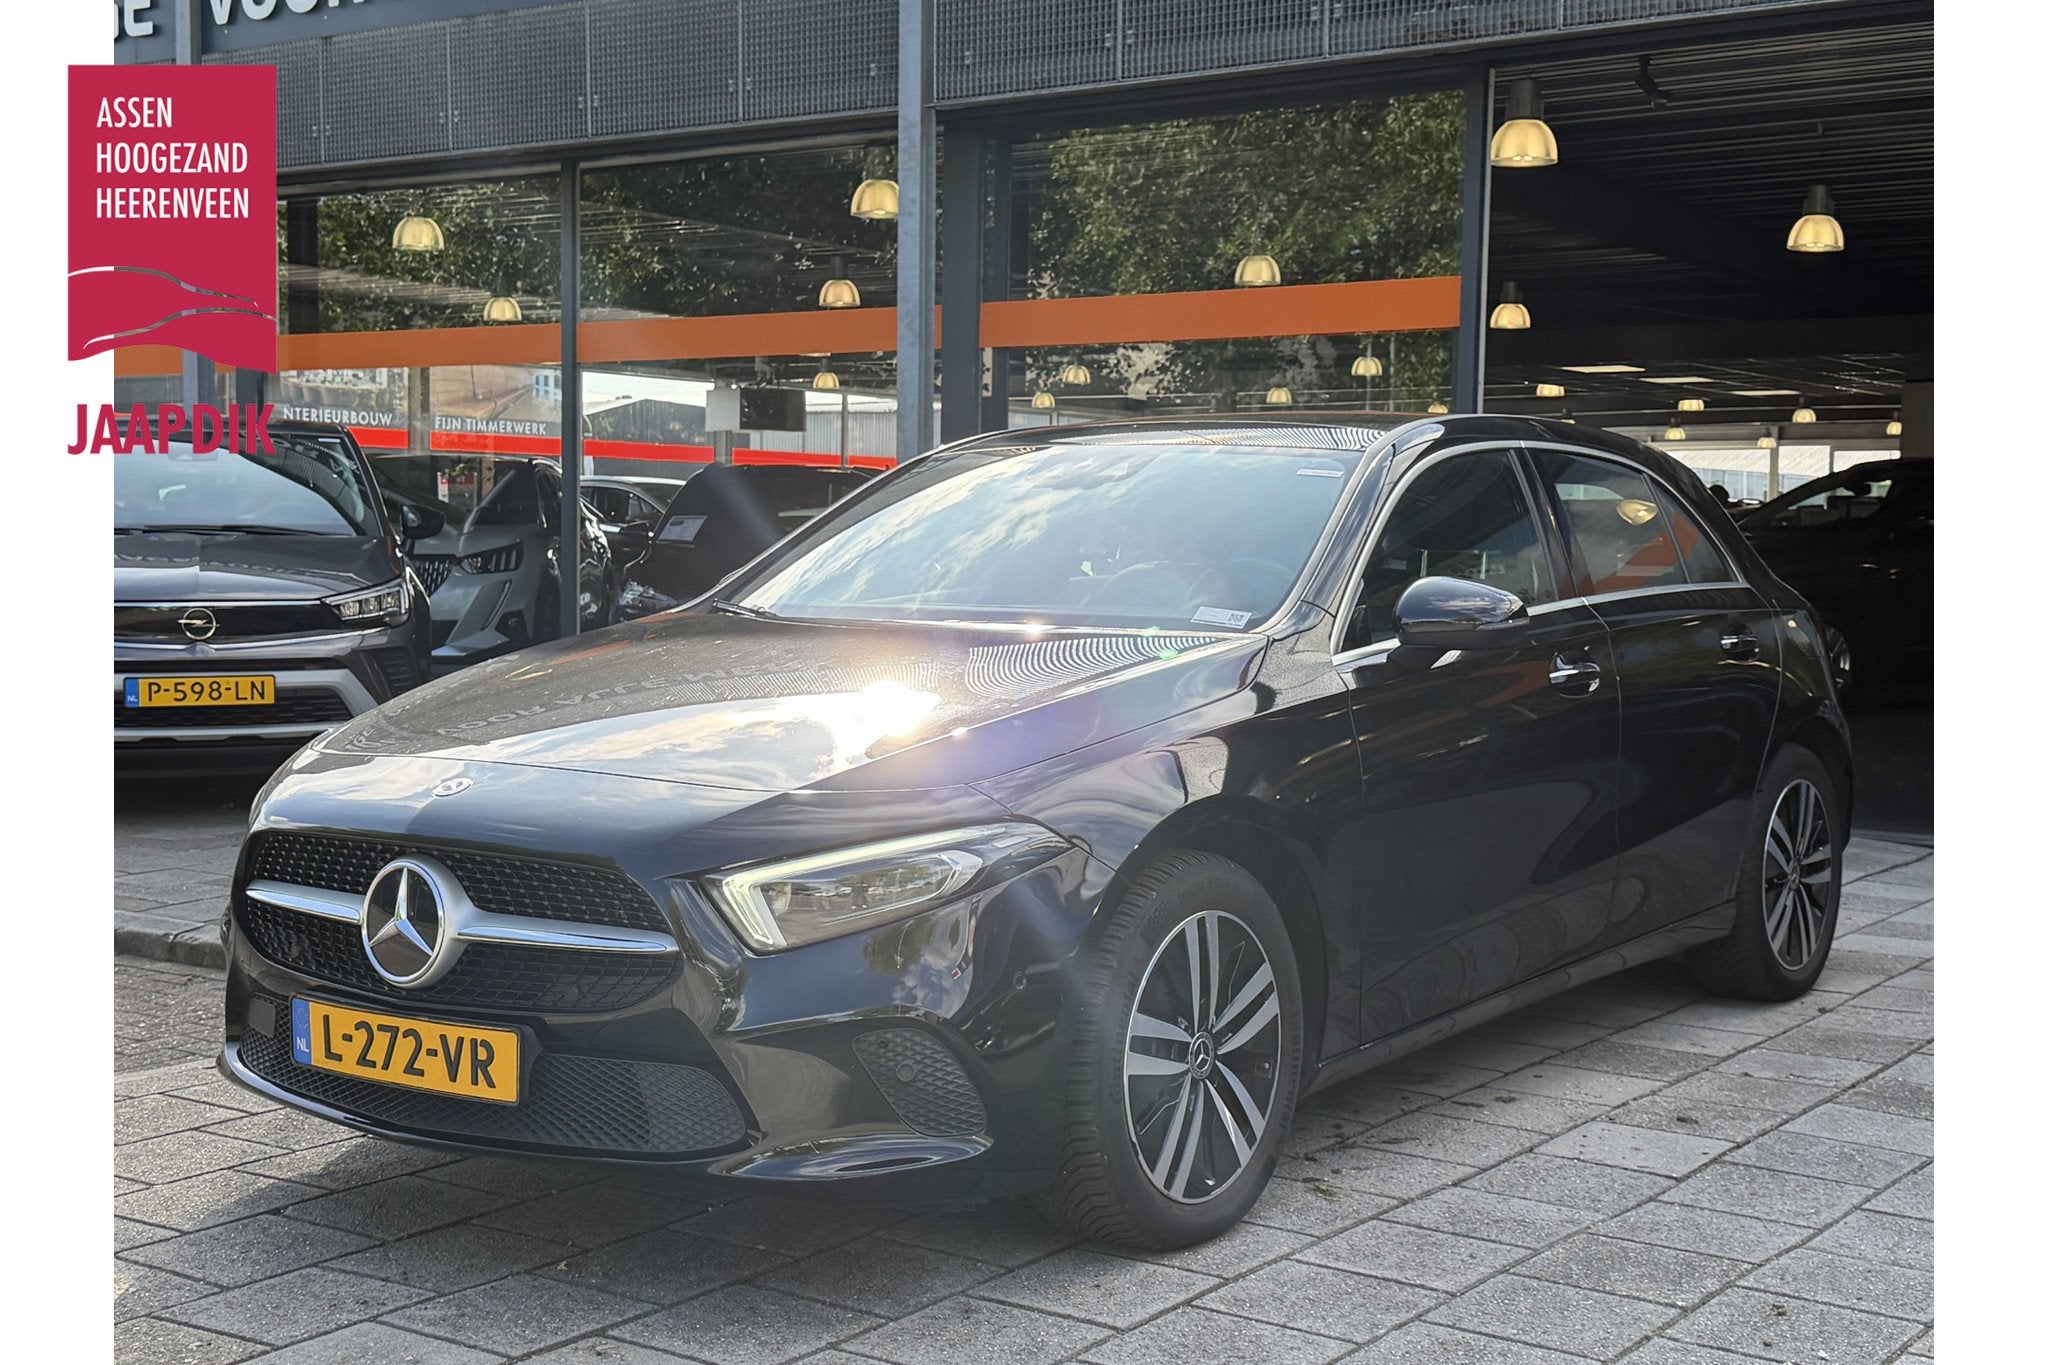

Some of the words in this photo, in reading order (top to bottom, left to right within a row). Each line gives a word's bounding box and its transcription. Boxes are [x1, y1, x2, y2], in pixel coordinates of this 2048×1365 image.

[434, 416, 462, 430] FIJN
[465, 418, 547, 436] TIMMERWERK
[147, 680, 266, 702] P-598-LN
[296, 1036, 310, 1053] NL
[322, 1013, 497, 1089] L-272-VR
